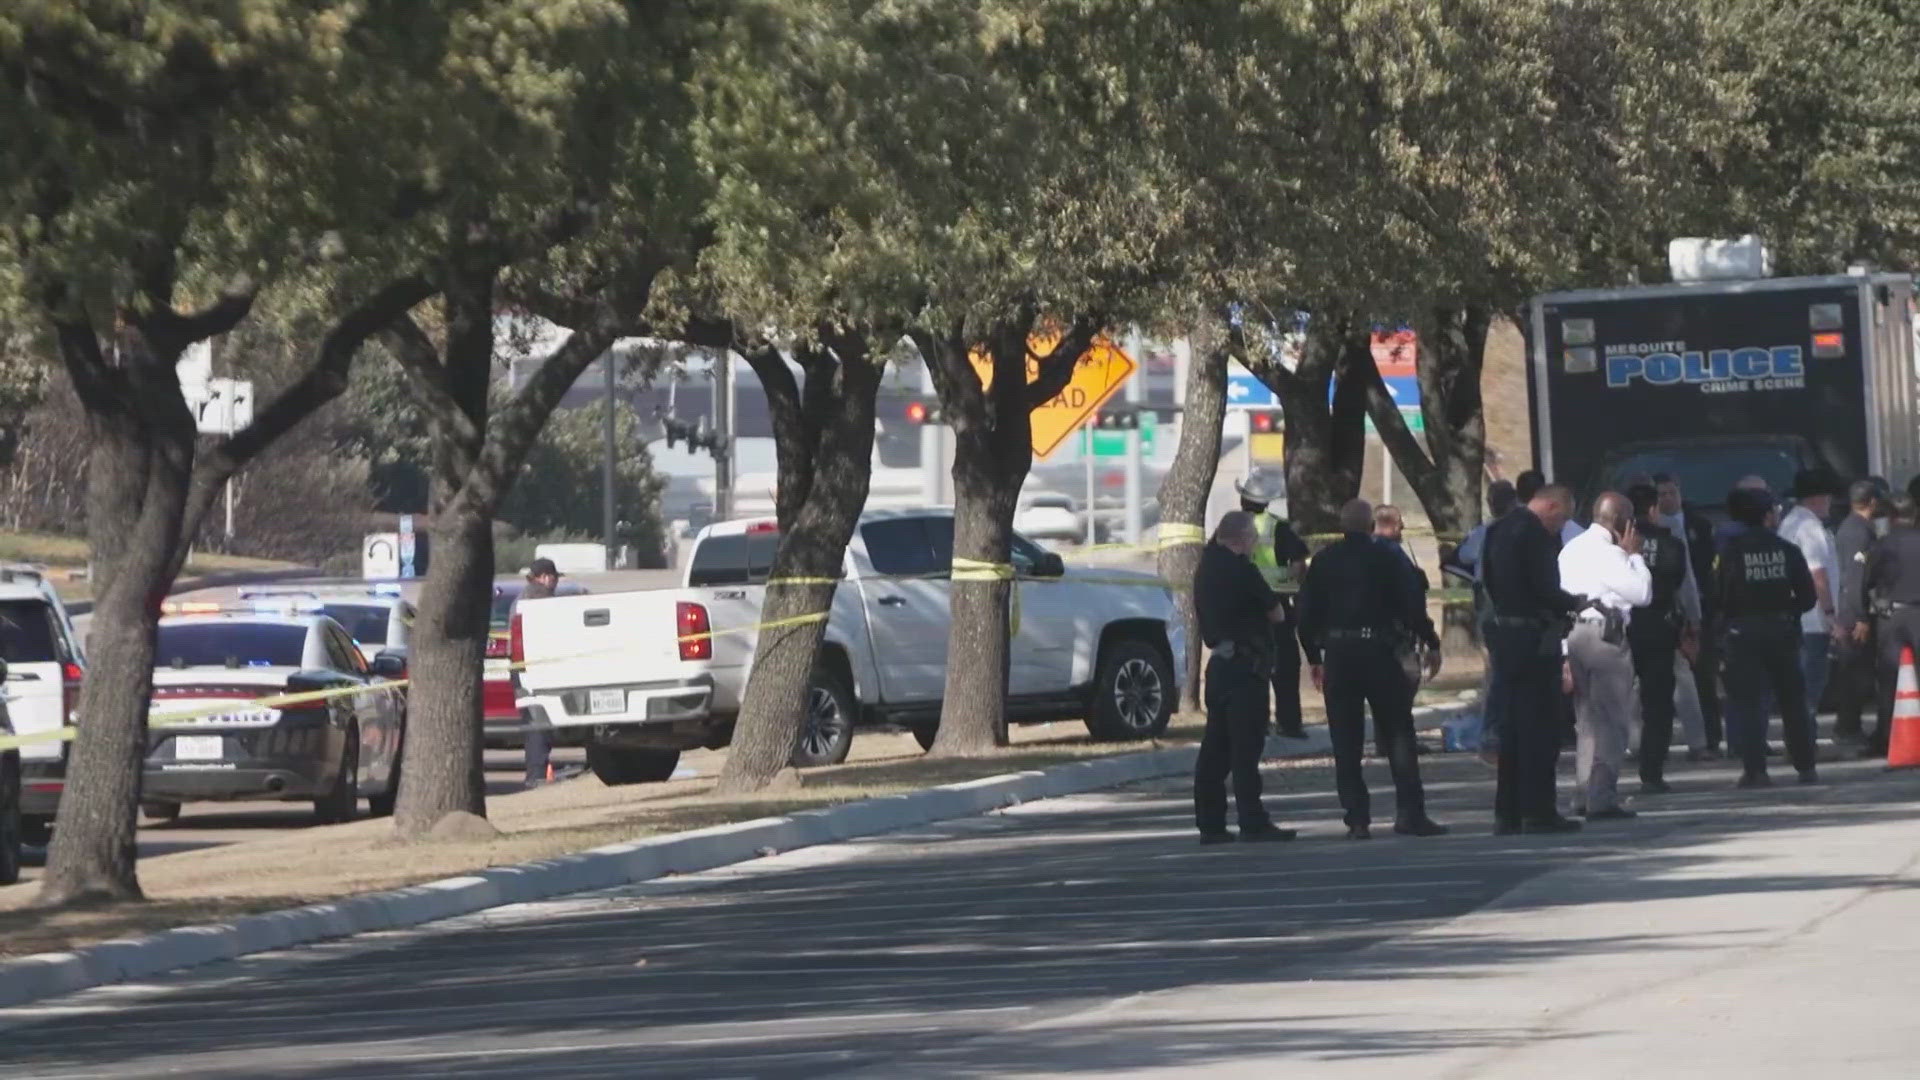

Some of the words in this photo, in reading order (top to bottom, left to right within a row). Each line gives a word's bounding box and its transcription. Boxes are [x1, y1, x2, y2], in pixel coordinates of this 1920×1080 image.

[1606, 341, 1685, 354] MESQUITE
[1607, 345, 1804, 387] POLICE
[1700, 381, 1748, 393] CRIME
[1755, 377, 1804, 390] SCENE
[1745, 551, 1785, 565] DALLAS
[1746, 565, 1785, 580] POLICE
